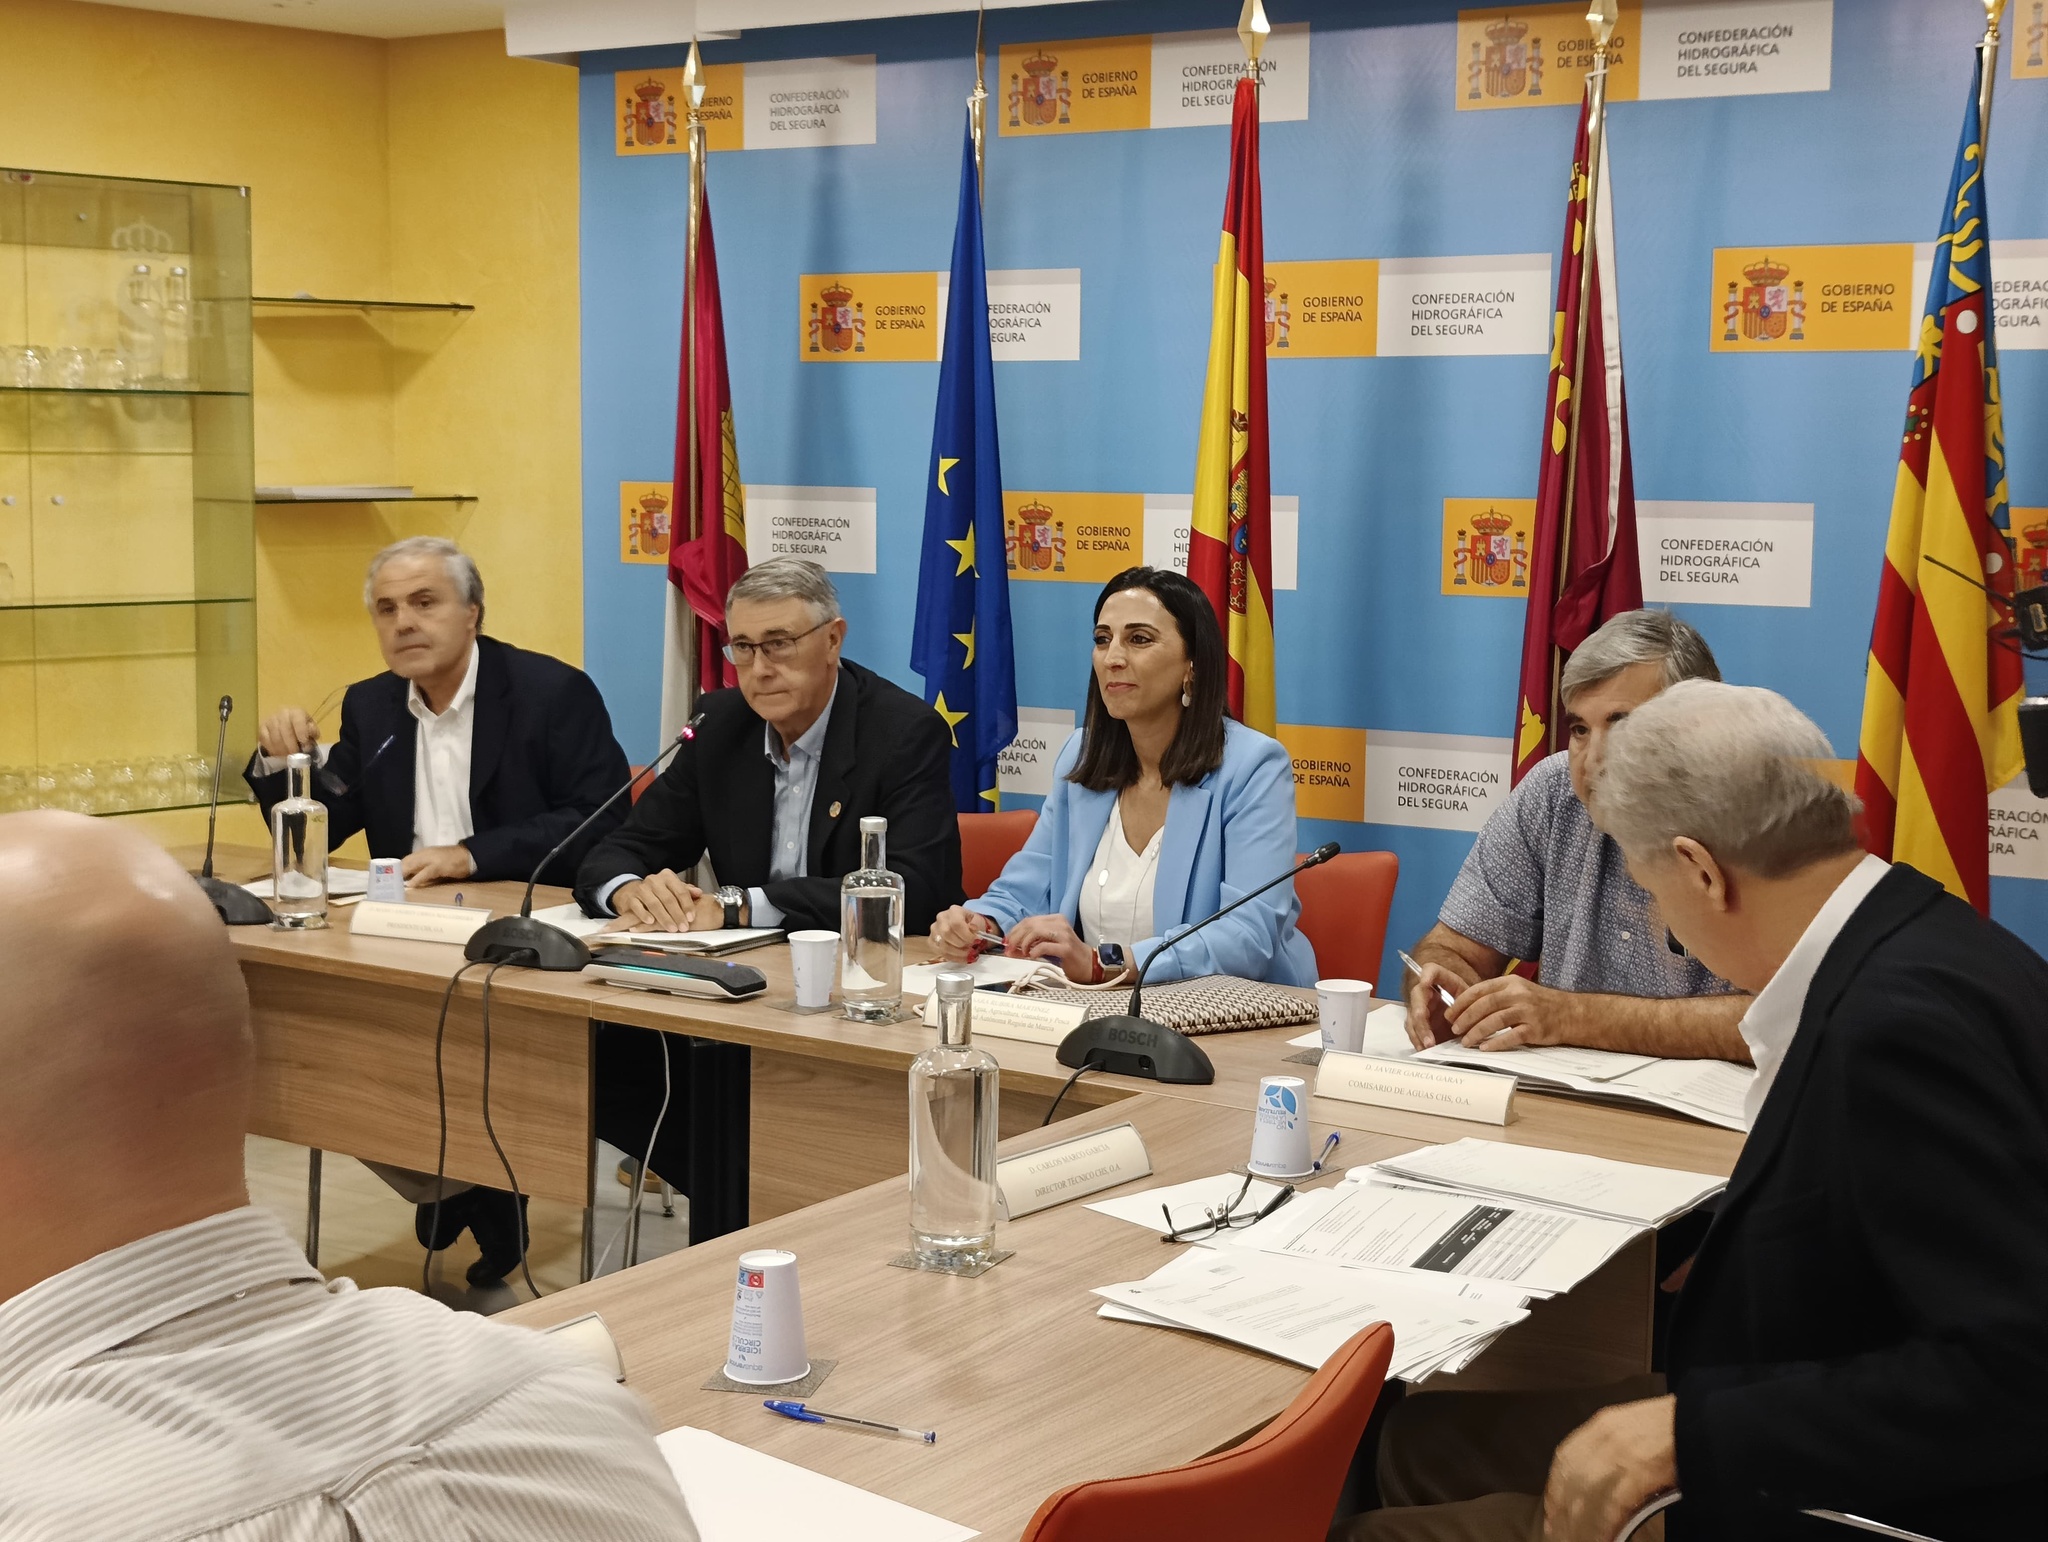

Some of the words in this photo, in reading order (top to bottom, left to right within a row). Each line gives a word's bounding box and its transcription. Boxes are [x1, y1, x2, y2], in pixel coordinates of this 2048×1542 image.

[1678, 24, 1793, 45] CONFEDERACIÓN
[1557, 36, 1625, 52] GOBIENO
[1678, 43, 1780, 61] HIDROGRÁFICA
[1182, 59, 1277, 77] CONFEDERAÓN
[1557, 56, 1572, 68] DE
[1677, 65, 1702, 77] DEL
[1704, 61, 1758, 76] SEGURA
[1082, 70, 1139, 85] GOBIERNO
[769, 88, 849, 103] CONFEDERACIÓN
[1082, 87, 1096, 99] DE
[1098, 83, 1138, 98] ESPAÑA
[1182, 96, 1202, 107] DEL
[1204, 94, 1233, 106] SEGU
[700, 109, 733, 121] ESPAÑA
[769, 104, 841, 117] HIDROGRÁFICA
[769, 121, 787, 131] DEL
[789, 122, 827, 131] SEGURA
[1821, 283, 1895, 297] GOBIERNO
[1303, 295, 1364, 308] GOBIERNO
[1411, 290, 1515, 306] CONFEDERACIÓN
[1821, 300, 1838, 313] DE
[1842, 297, 1893, 313] ESPAÑA
[875, 305, 926, 316] GOBIERNO
[1303, 311, 1316, 323] DE
[1320, 308, 1363, 322] ESPAÑA
[1411, 304, 1503, 320] HIDROGRÁFICA
[875, 320, 887, 330] DE
[890, 317, 925, 330] ESPAÑA
[989, 316, 1042, 328] OGRÁFICA
[991, 332, 1026, 342] EGURA
[1411, 325, 1433, 336] DEL
[1434, 324, 1484, 336] SEGURA
[771, 516, 850, 529] CONFEDERACIÓN
[771, 529, 842, 542] HIDROGRÁFICA
[1076, 525, 1131, 537] GOBIERNO
[771, 543, 789, 553] DEL
[790, 544, 828, 554] SEGURA
[1076, 540, 1089, 550] DE
[1092, 538, 1130, 551] ESPAÑA
[1660, 538, 1774, 552] CONFEDERACIÓN
[1173, 557, 1187, 567] DE
[1660, 553, 1760, 568] HIDROGRÁFICA
[1659, 571, 1684, 582] DEL
[1686, 571, 1739, 584] SEGURA
[1292, 758, 1351, 773] GOBIERNO
[1292, 773, 1305, 784] DE
[1309, 774, 1350, 787] ESPAÑA
[1398, 766, 1499, 784] CONFEDERACIÓN
[1398, 781, 1487, 798] HIDROGRÁFICA
[1397, 796, 1420, 808] DEL
[1421, 798, 1469, 811] SEGURA
[1027, 1021, 1035, 1030] de
[1108, 1027, 1158, 1048] BOSCH
[1365, 1063, 1373, 1071] D.
[1373, 1064, 1402, 1075] JAVIER
[1403, 1069, 1434, 1081] GARCÍA
[1435, 1073, 1465, 1085] GARAY
[1348, 1079, 1393, 1093] COMISARIO
[1393, 1086, 1405, 1095] DE
[1406, 1088, 1434, 1099] AGUAS
[1435, 1092, 1453, 1104] CHS,
[1028, 1166, 1037, 1174] D.
[1037, 1156, 1063, 1171] CARLOS
[1062, 1150, 1086, 1165] MARCO
[1035, 1179, 1068, 1198] DIRECTOR
[1094, 1167, 1110, 1180] CHS,
